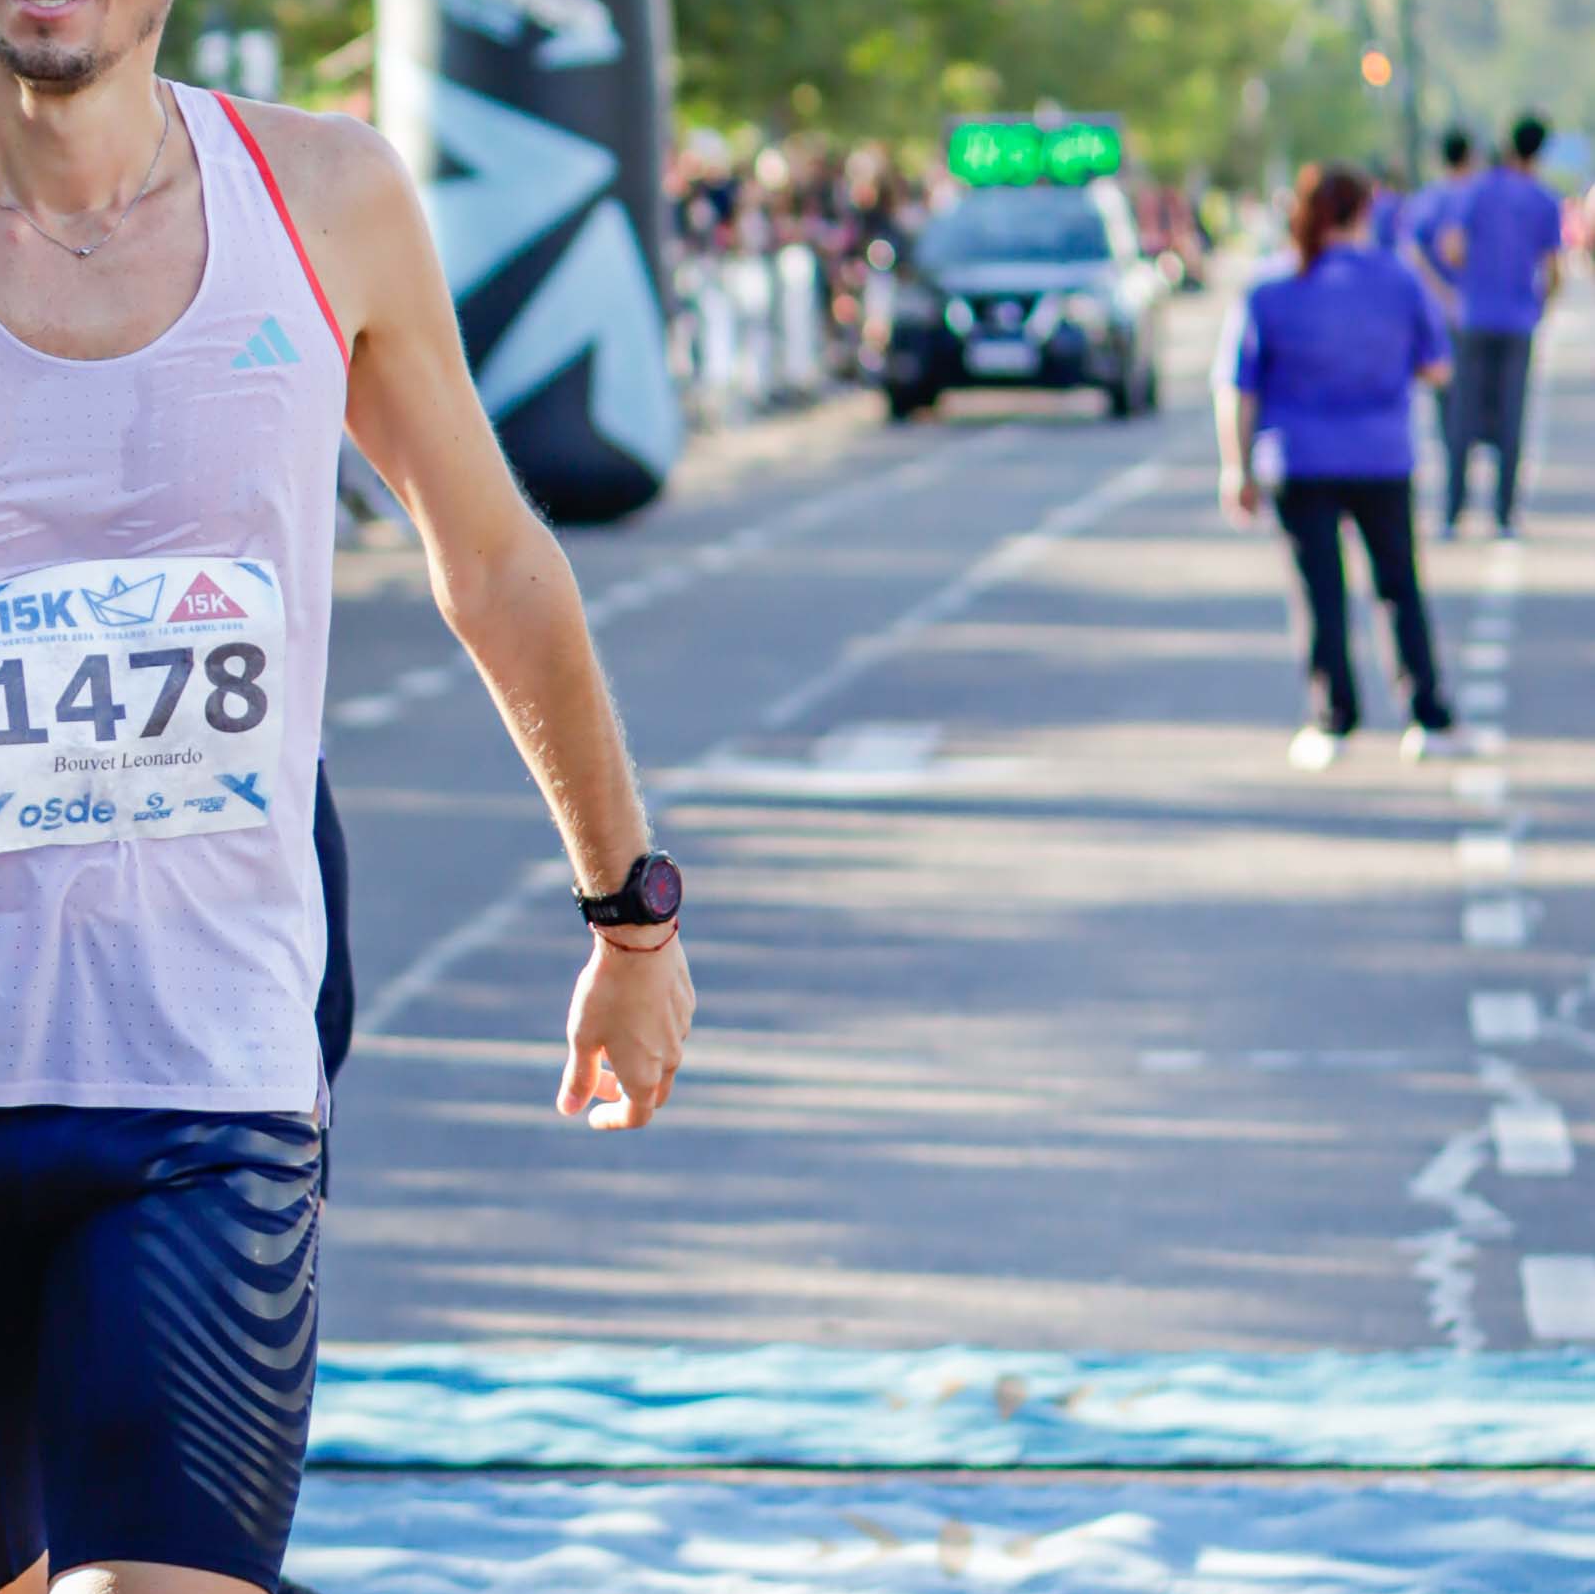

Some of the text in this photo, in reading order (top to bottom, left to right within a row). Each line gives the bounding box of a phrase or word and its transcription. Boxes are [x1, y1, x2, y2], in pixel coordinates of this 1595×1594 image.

[184, 591, 229, 615] 15K
[54, 748, 203, 773] Bouvet Leonardo
[19, 791, 117, 831] osde
